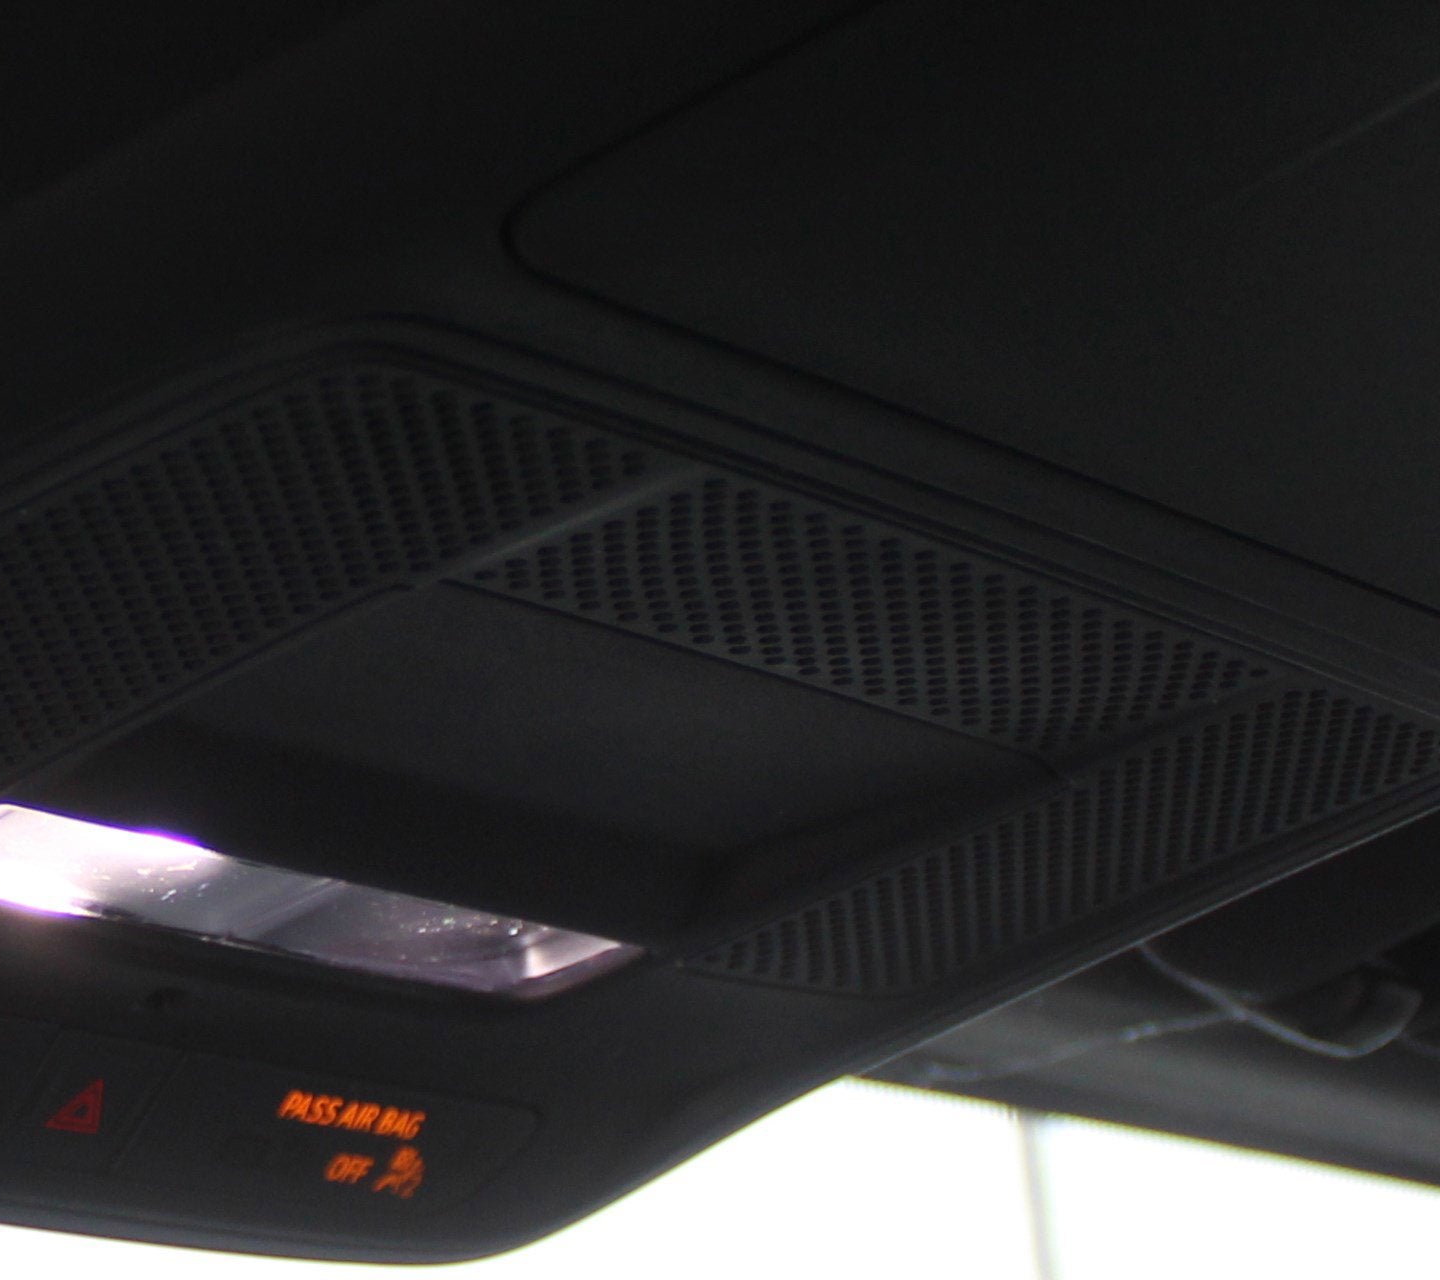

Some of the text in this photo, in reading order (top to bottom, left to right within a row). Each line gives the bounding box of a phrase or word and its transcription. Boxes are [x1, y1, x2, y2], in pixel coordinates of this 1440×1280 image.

[277, 1088, 427, 1141] PASS AIR BAG
[325, 1153, 375, 1184] OFF
